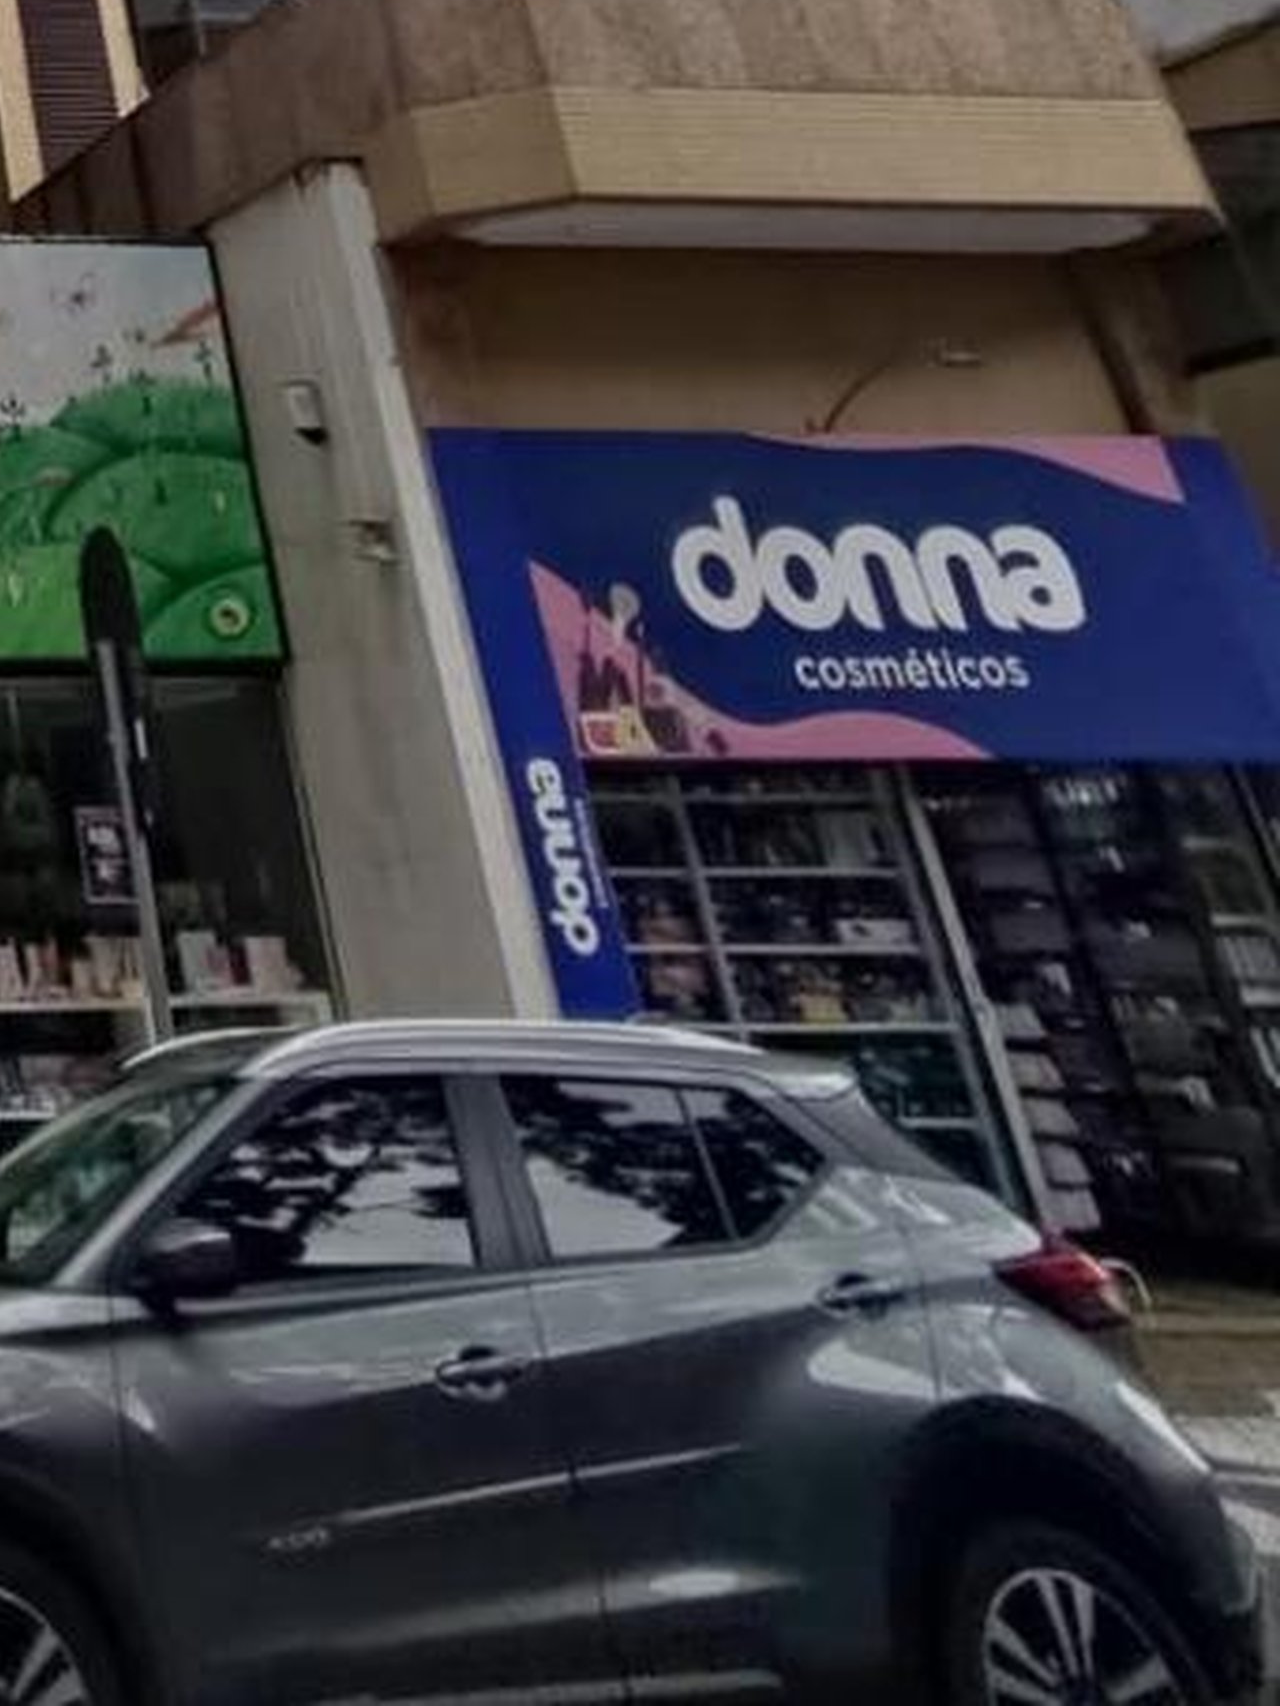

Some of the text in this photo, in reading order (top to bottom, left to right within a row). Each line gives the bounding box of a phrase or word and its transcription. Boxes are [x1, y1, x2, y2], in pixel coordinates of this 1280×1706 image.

[671, 494, 1087, 632] donna
[793, 648, 1032, 691] cosméticos
[526, 756, 600, 957] donna
